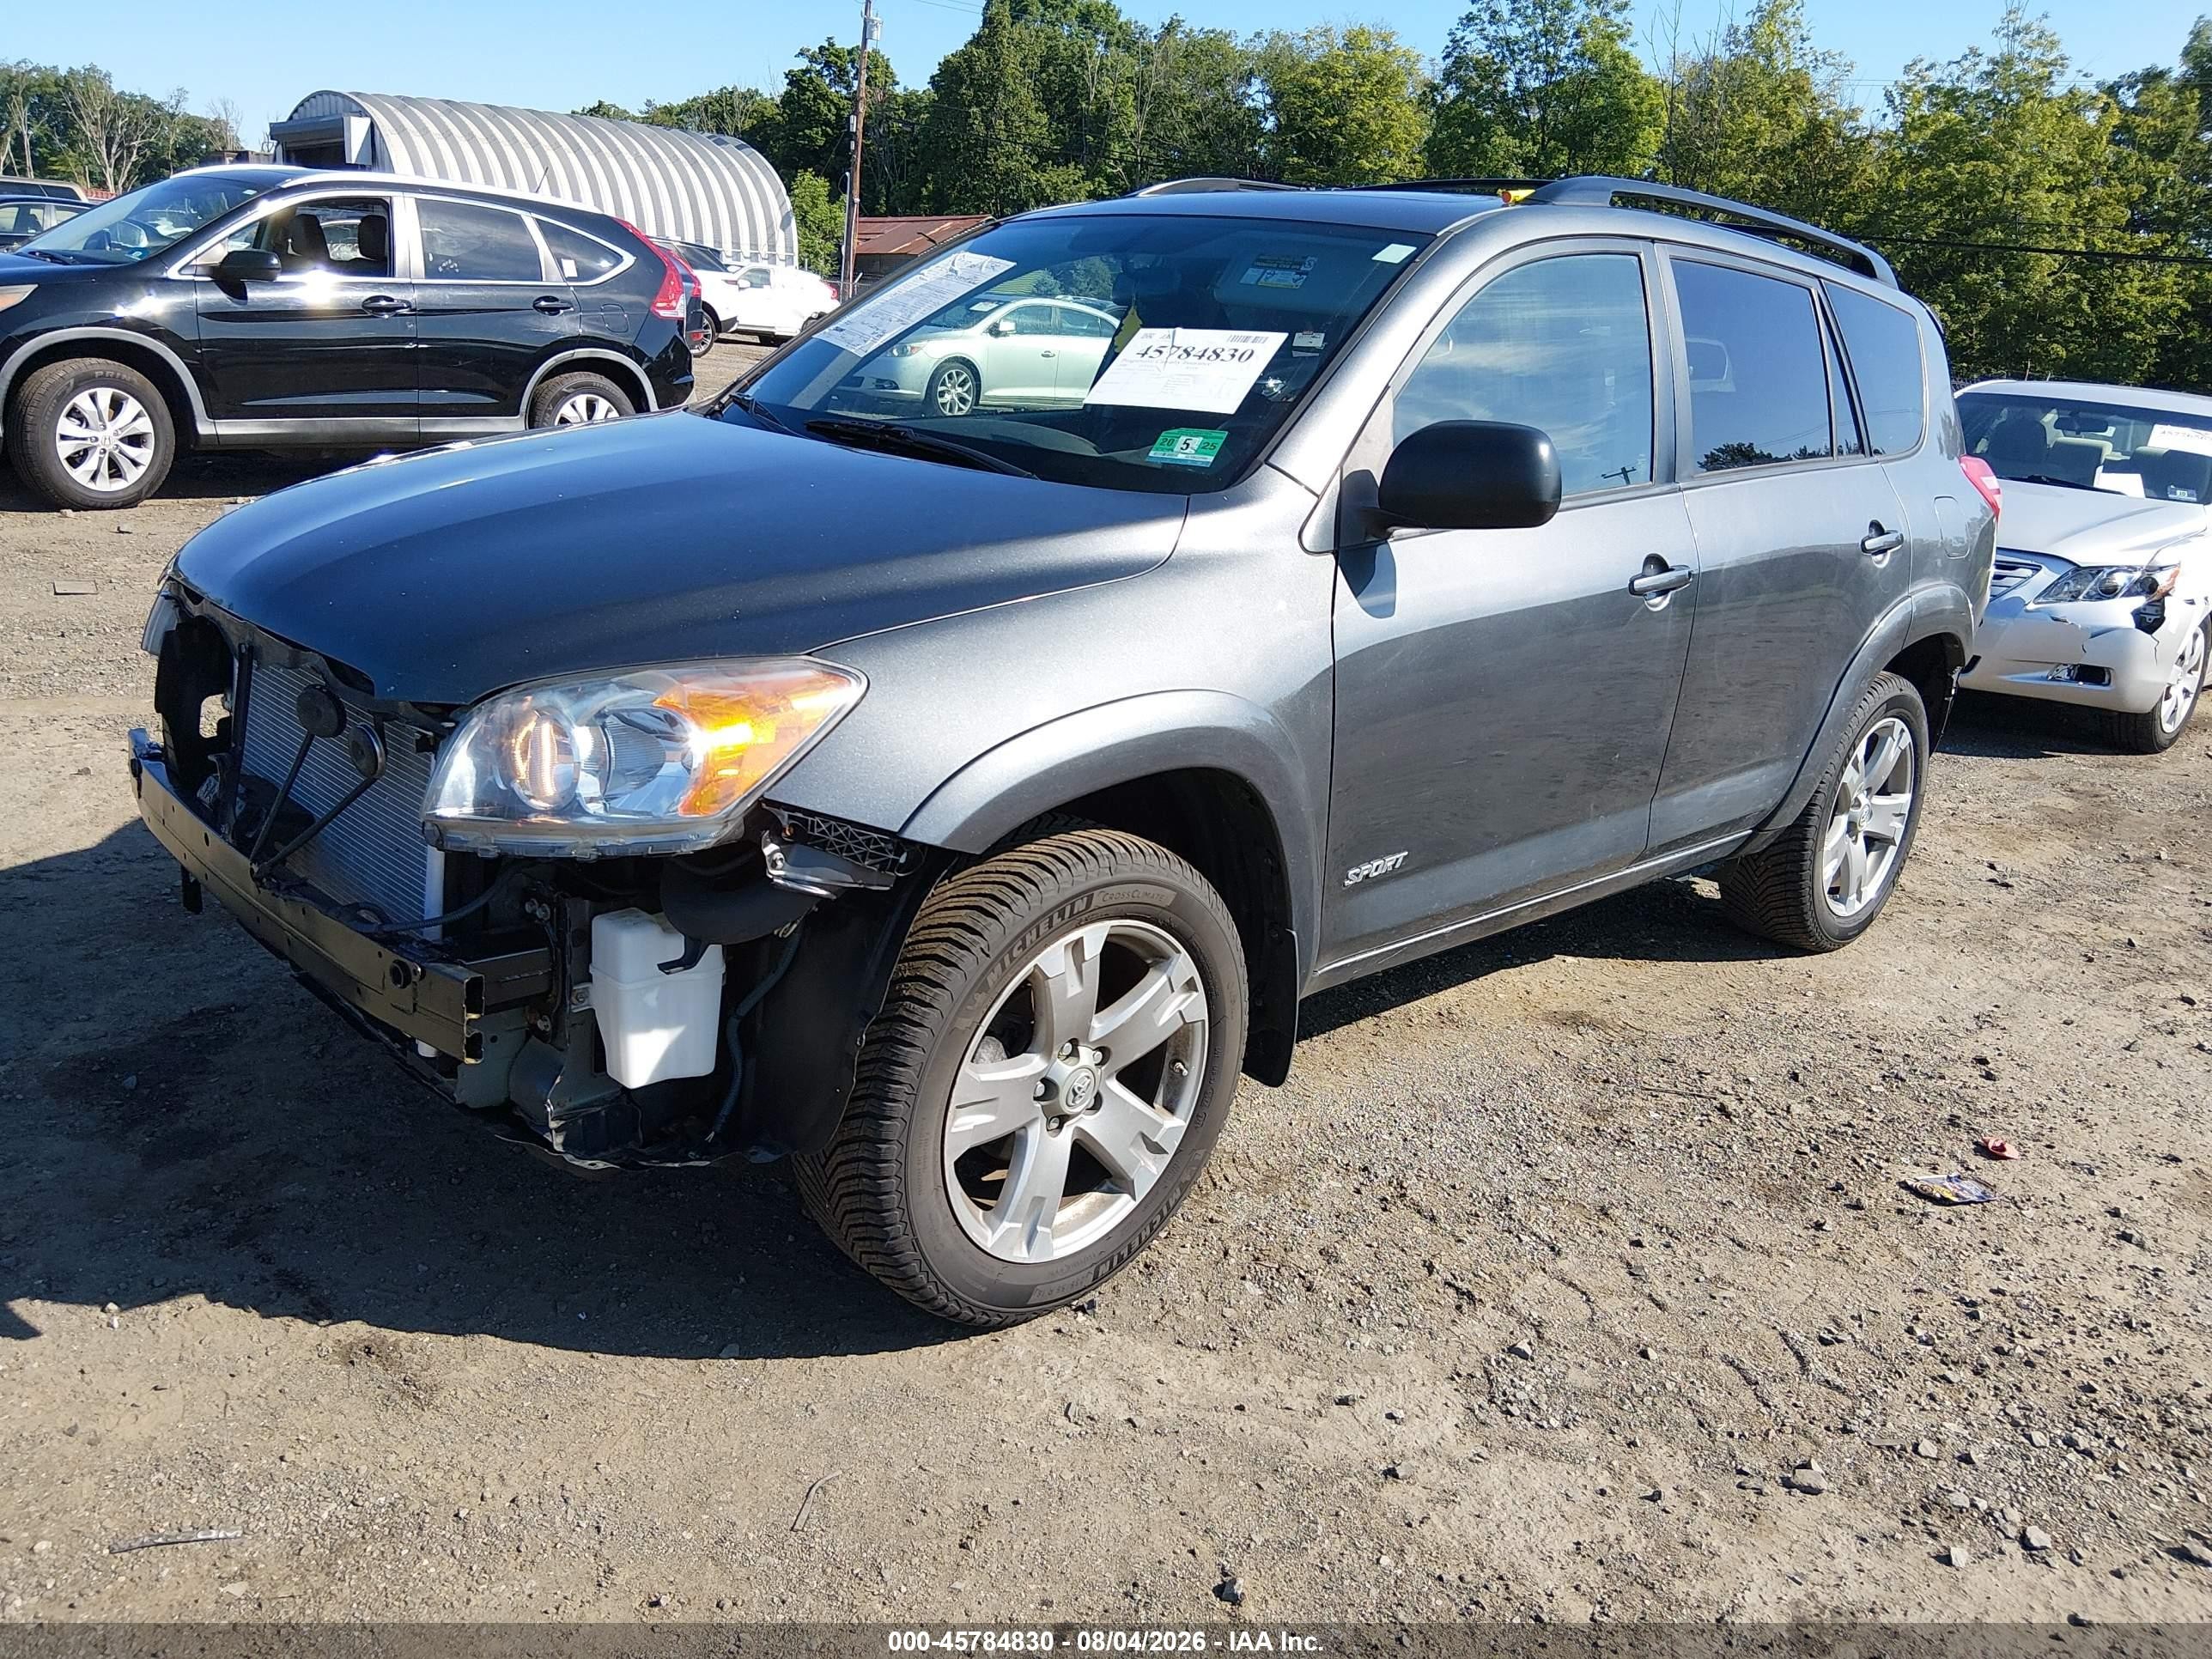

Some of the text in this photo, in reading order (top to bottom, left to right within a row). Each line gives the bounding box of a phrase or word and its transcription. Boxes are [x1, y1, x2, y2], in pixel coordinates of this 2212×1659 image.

[1135, 344, 1255, 363] 45784830
[1159, 438, 1218, 451] 20 5 25
[1343, 851, 1408, 886] SPORT
[987, 894, 1089, 986] MICHELIN
